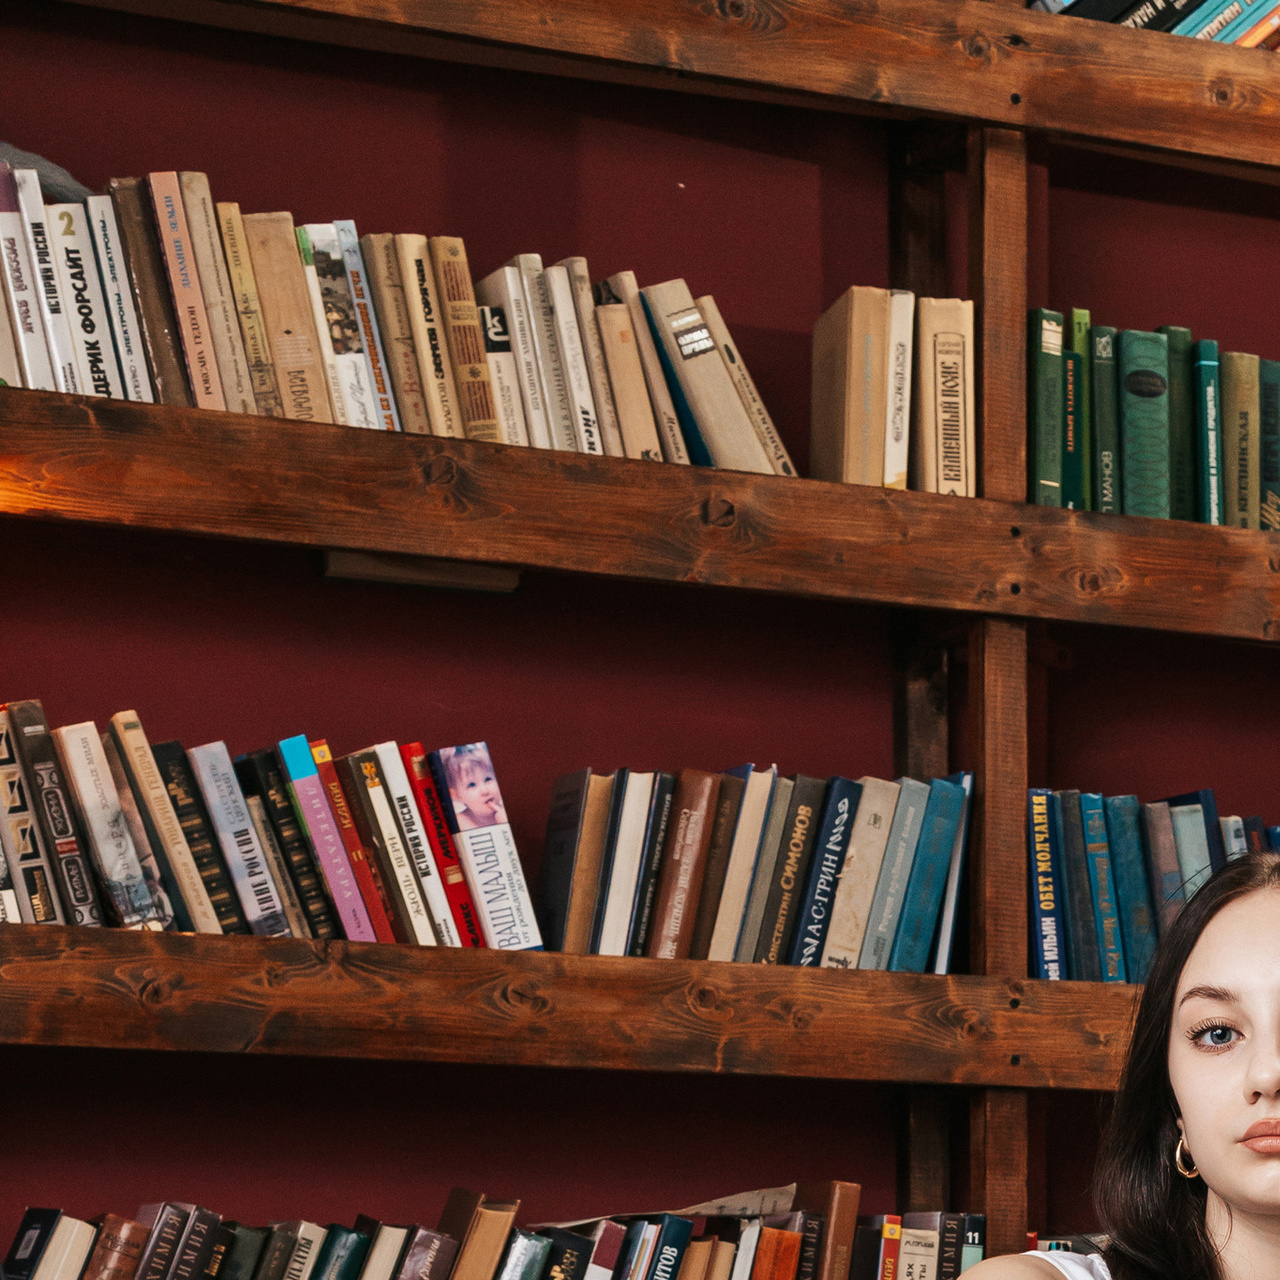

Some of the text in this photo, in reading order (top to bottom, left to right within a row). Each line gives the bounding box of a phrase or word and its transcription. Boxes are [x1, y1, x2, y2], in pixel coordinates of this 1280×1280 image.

[58, 211, 76, 236] 2
[163, 194, 178, 232] ЗЕМЛИ
[31, 221, 60, 315] ИСТОРИЯ РОССИИ
[64, 245, 95, 335] ФОРСАЙТ
[940, 361, 961, 482] КАМЕННЫЙ ПОЯС
[233, 827, 263, 878] РОССИИ
[308, 786, 350, 898] ЛИТЕРАТУРА
[395, 794, 431, 878] ИСТОРИЯ РОССИИ
[780, 806, 811, 890] СИМОНОВ
[1032, 794, 1052, 872] МОЛЧАНИЯ
[387, 835, 422, 917] ЖЮЛЬ ВЕРН
[469, 830, 520, 949] ВАШ МАЛЫШ
[1038, 875, 1055, 911] ОБЕТ
[1041, 916, 1059, 960] ИЛЬИН
[966, 1231, 980, 1244] 11
